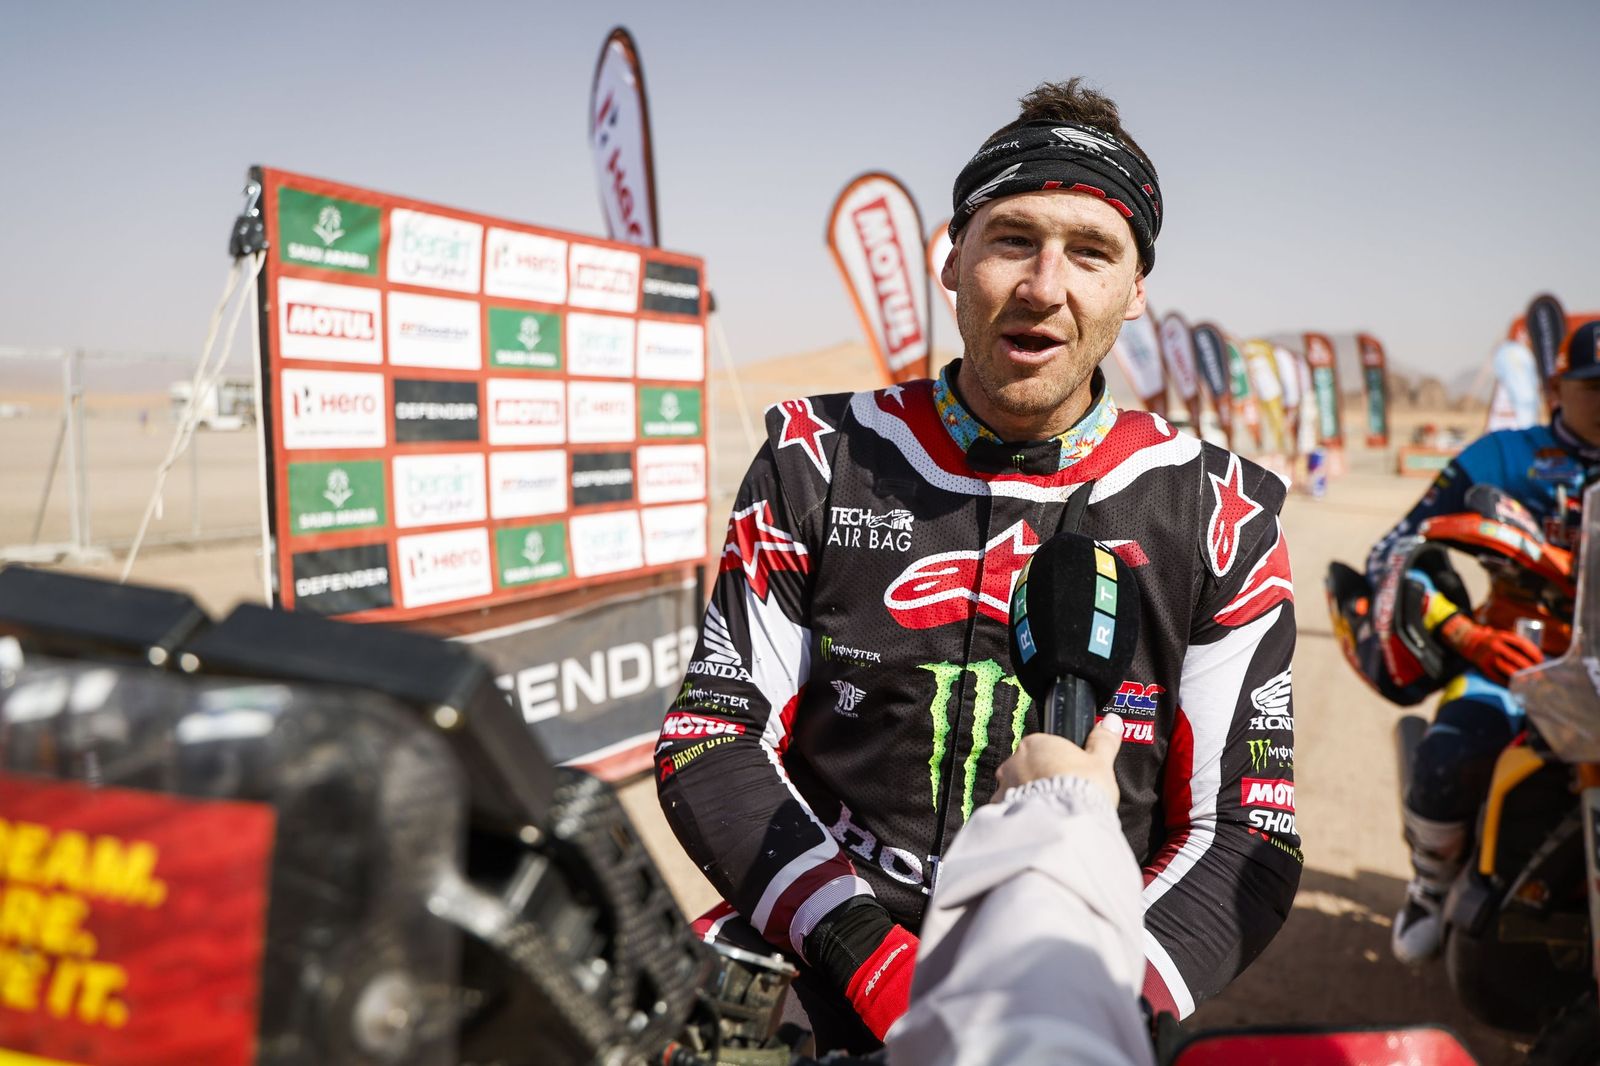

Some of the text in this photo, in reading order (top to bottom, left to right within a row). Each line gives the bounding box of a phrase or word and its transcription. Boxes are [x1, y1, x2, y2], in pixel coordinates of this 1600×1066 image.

[855, 206, 917, 350] MOTUL
[288, 305, 374, 338] MOTUL
[320, 392, 377, 415] Hero
[396, 402, 478, 420] DEFENDER
[827, 526, 912, 552] AIR BAG
[296, 567, 388, 597] DEFENDER
[831, 644, 881, 663] MONSTER
[688, 661, 755, 683] HONDA
[688, 688, 749, 710] MONSTER
[661, 716, 740, 736] MOTUL
[1248, 716, 1294, 731] HON
